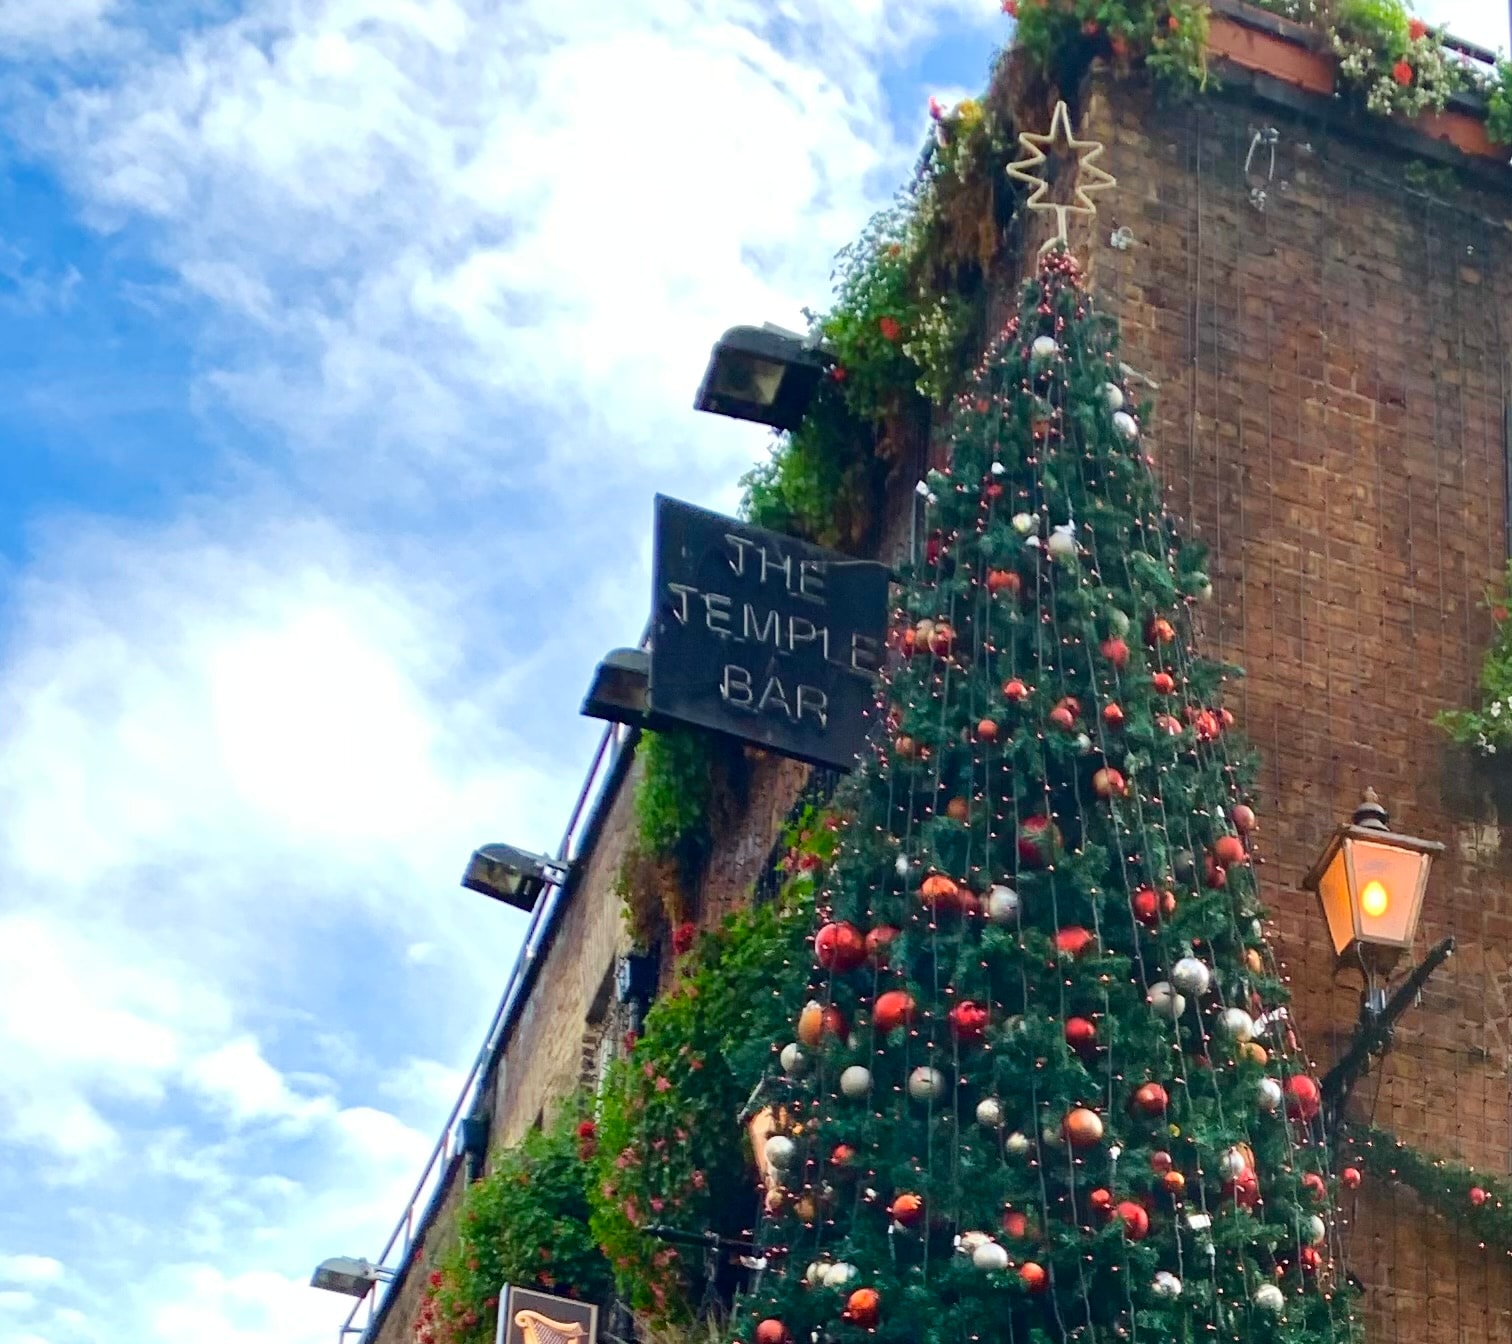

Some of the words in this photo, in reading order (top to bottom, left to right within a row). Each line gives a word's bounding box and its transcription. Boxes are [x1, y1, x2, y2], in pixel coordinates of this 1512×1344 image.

[724, 533, 826, 606] THE
[667, 582, 882, 682] TEMPLE
[721, 664, 827, 728] BAR
